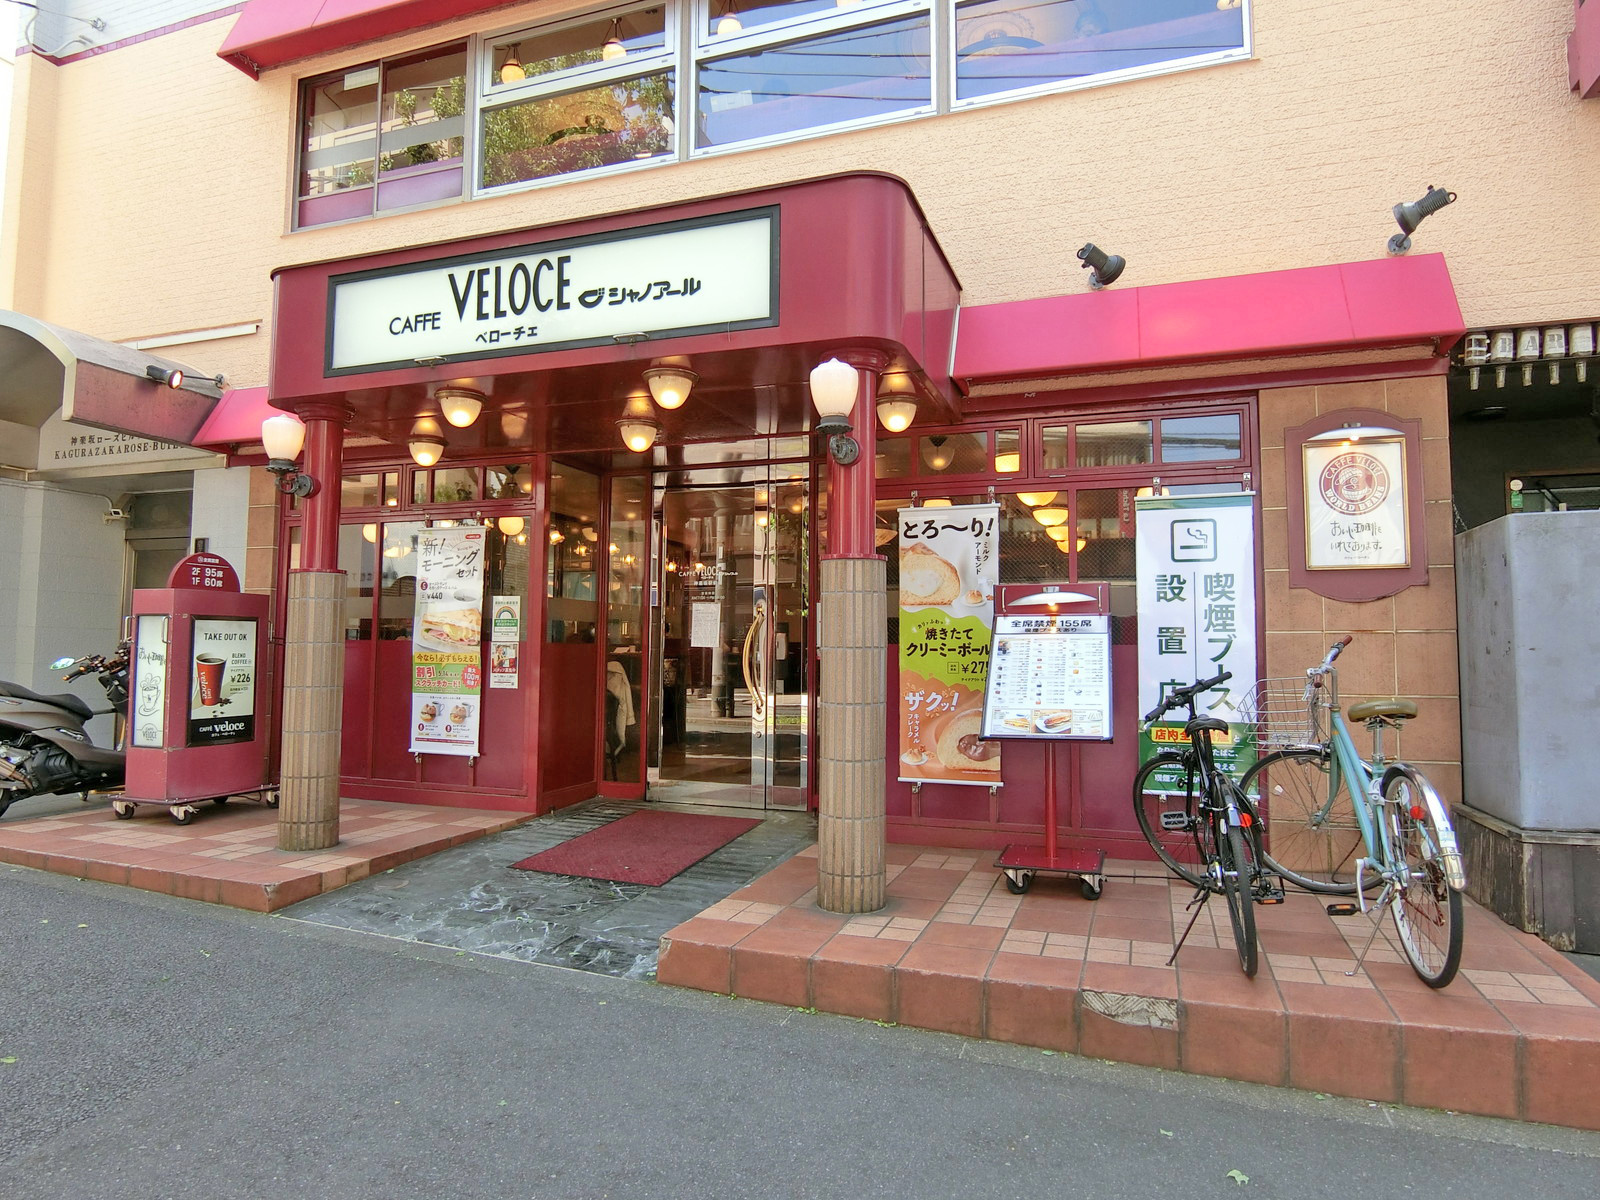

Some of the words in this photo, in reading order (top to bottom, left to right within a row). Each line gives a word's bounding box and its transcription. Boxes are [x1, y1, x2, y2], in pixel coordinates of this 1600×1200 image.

[389, 311, 442, 335] CAFFE
[447, 255, 571, 323] VELOCE
[608, 277, 702, 306] シャノアール
[475, 325, 538, 344] ベローチェ
[421, 548, 481, 572] モーニング
[192, 567, 201, 576] 2F
[456, 566, 478, 578] セット
[192, 577, 201, 586] 1F
[1060, 620, 1093, 628] 155席
[204, 632, 223, 641] TAKE
[224, 633, 238, 641] OUT
[238, 633, 248, 641] OK
[925, 627, 974, 641] 焼きたて
[1203, 572, 1237, 711] 喫煙ブース
[906, 642, 990, 658] クリーミーボール
[230, 673, 251, 683] ¥226
[415, 665, 436, 678] 割引
[214, 720, 246, 733] veloce
